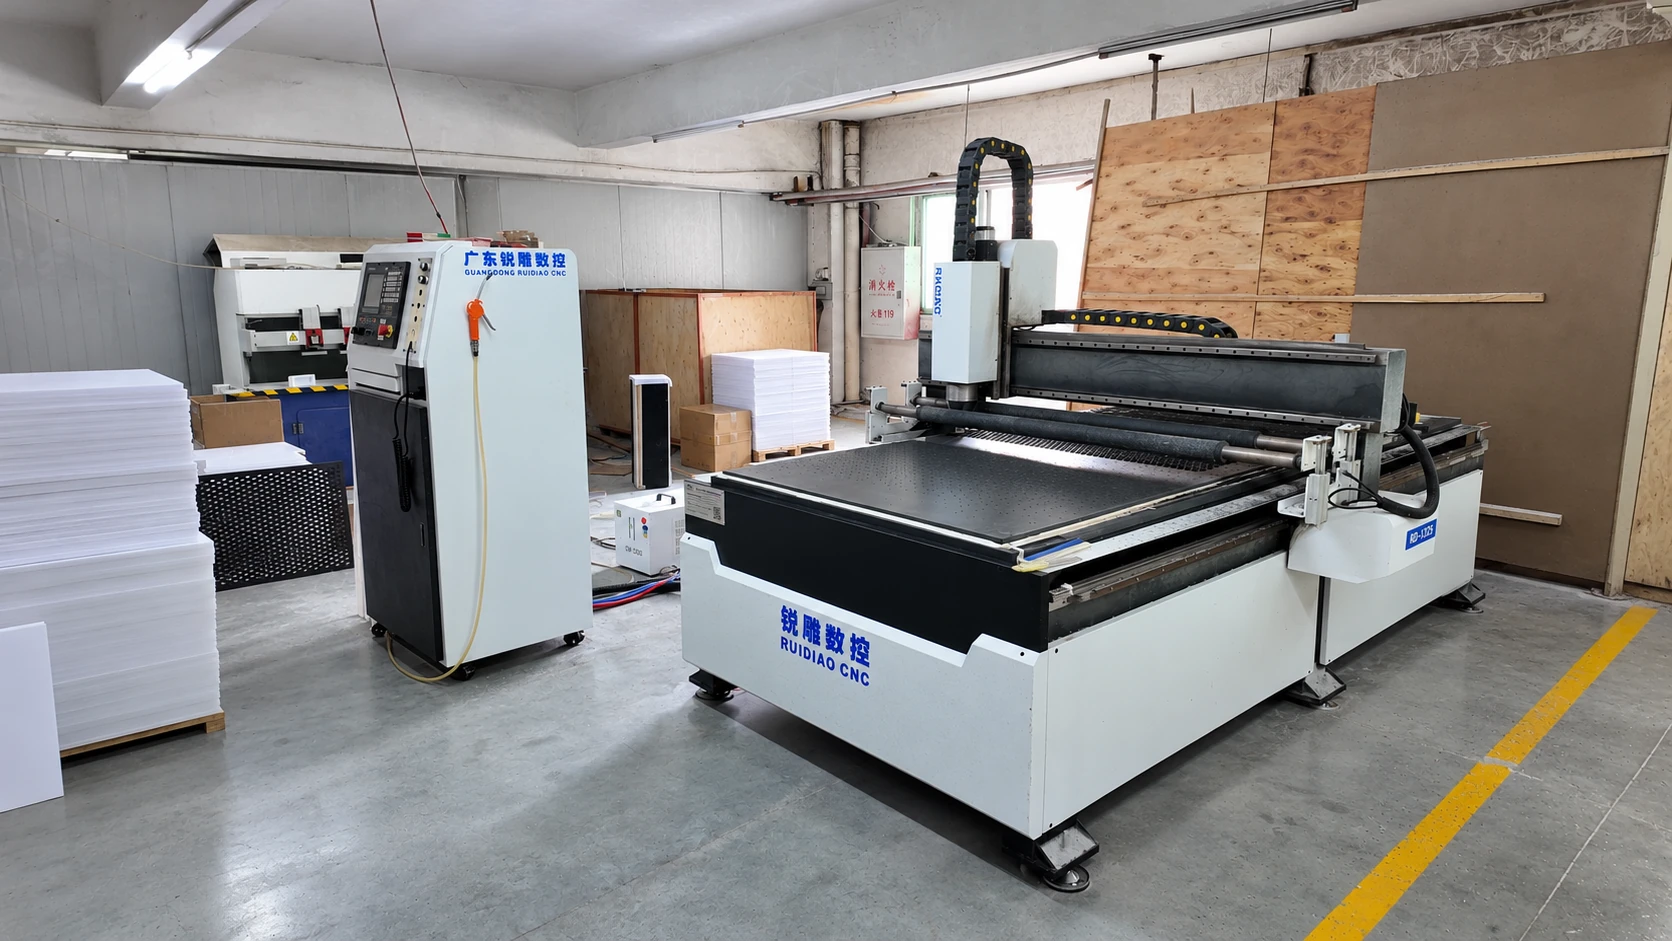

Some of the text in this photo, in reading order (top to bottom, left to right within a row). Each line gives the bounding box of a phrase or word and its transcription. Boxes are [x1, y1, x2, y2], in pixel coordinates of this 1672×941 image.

[464, 250, 566, 268] 广东锐雕数控
[781, 605, 870, 668] 锐雕数控
[781, 636, 870, 687] RUIDIAO CNC
